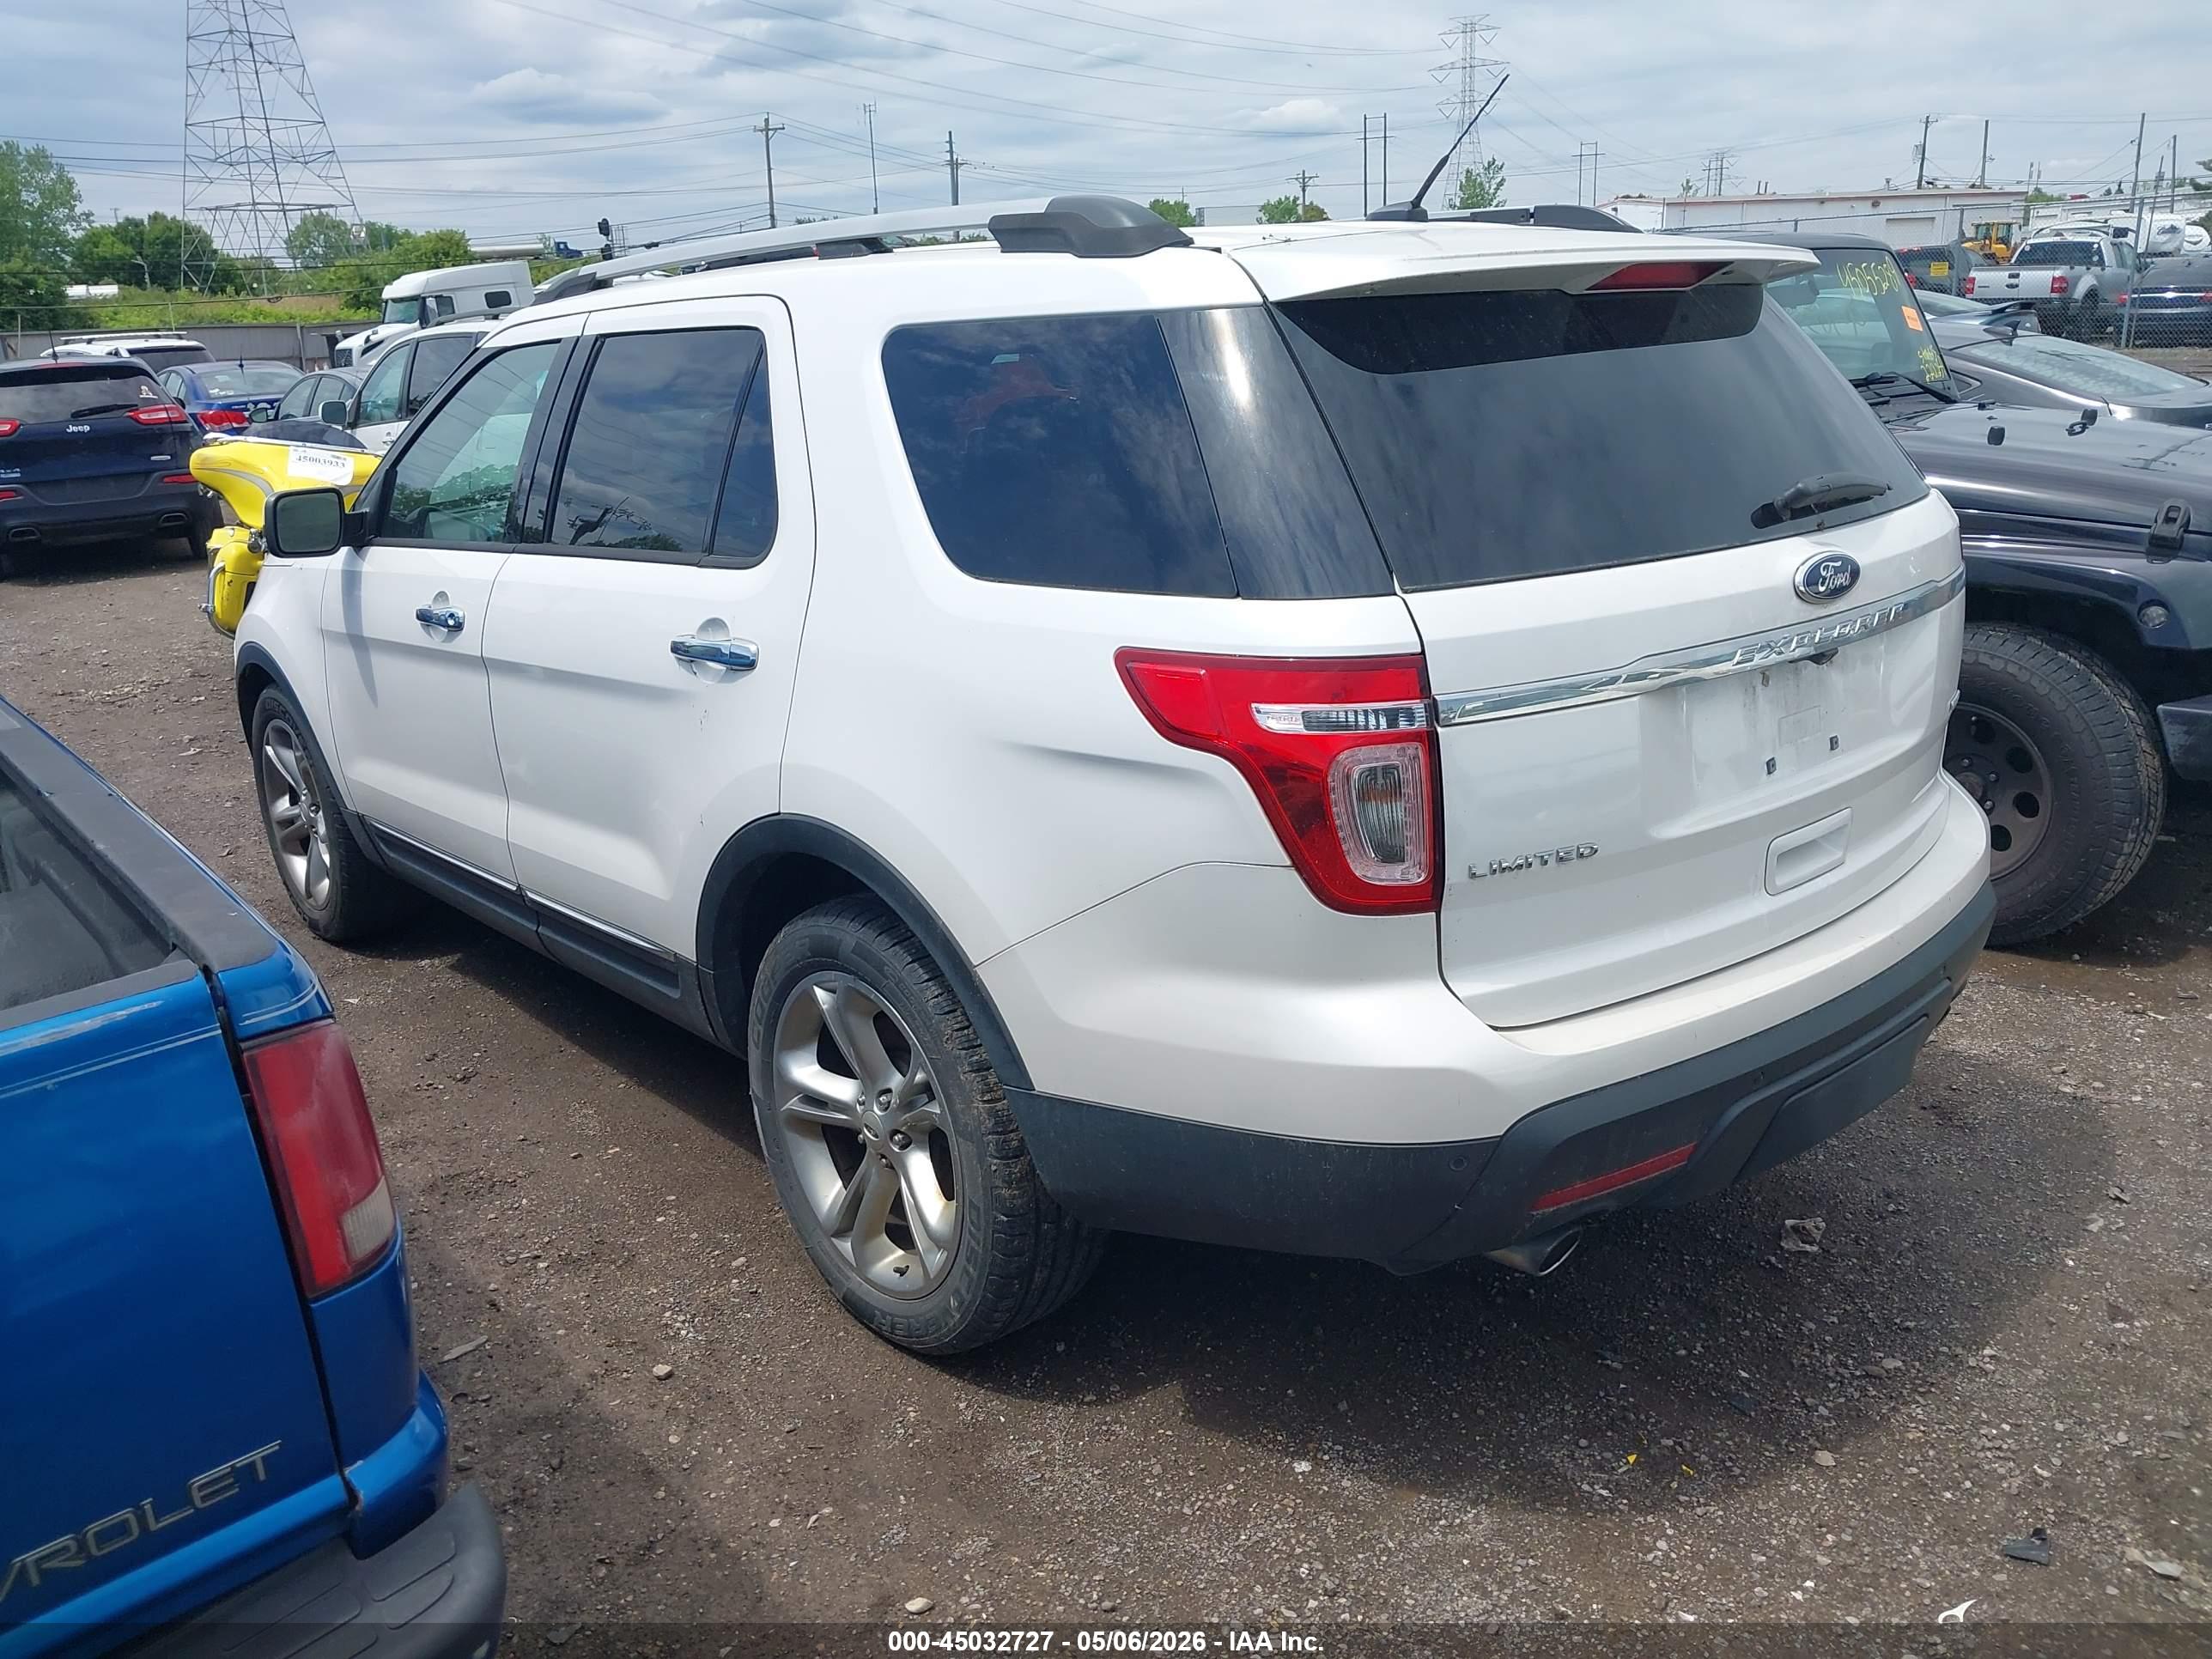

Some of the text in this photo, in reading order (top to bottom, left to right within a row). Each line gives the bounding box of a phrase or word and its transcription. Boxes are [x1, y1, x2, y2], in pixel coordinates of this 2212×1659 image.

[66, 424, 91, 433] Jeep
[295, 454, 346, 469] 45003933
[1818, 560, 1852, 592] Ford
[1732, 602, 1905, 666] EXPLORER
[1468, 842, 1600, 879] LIMITED
